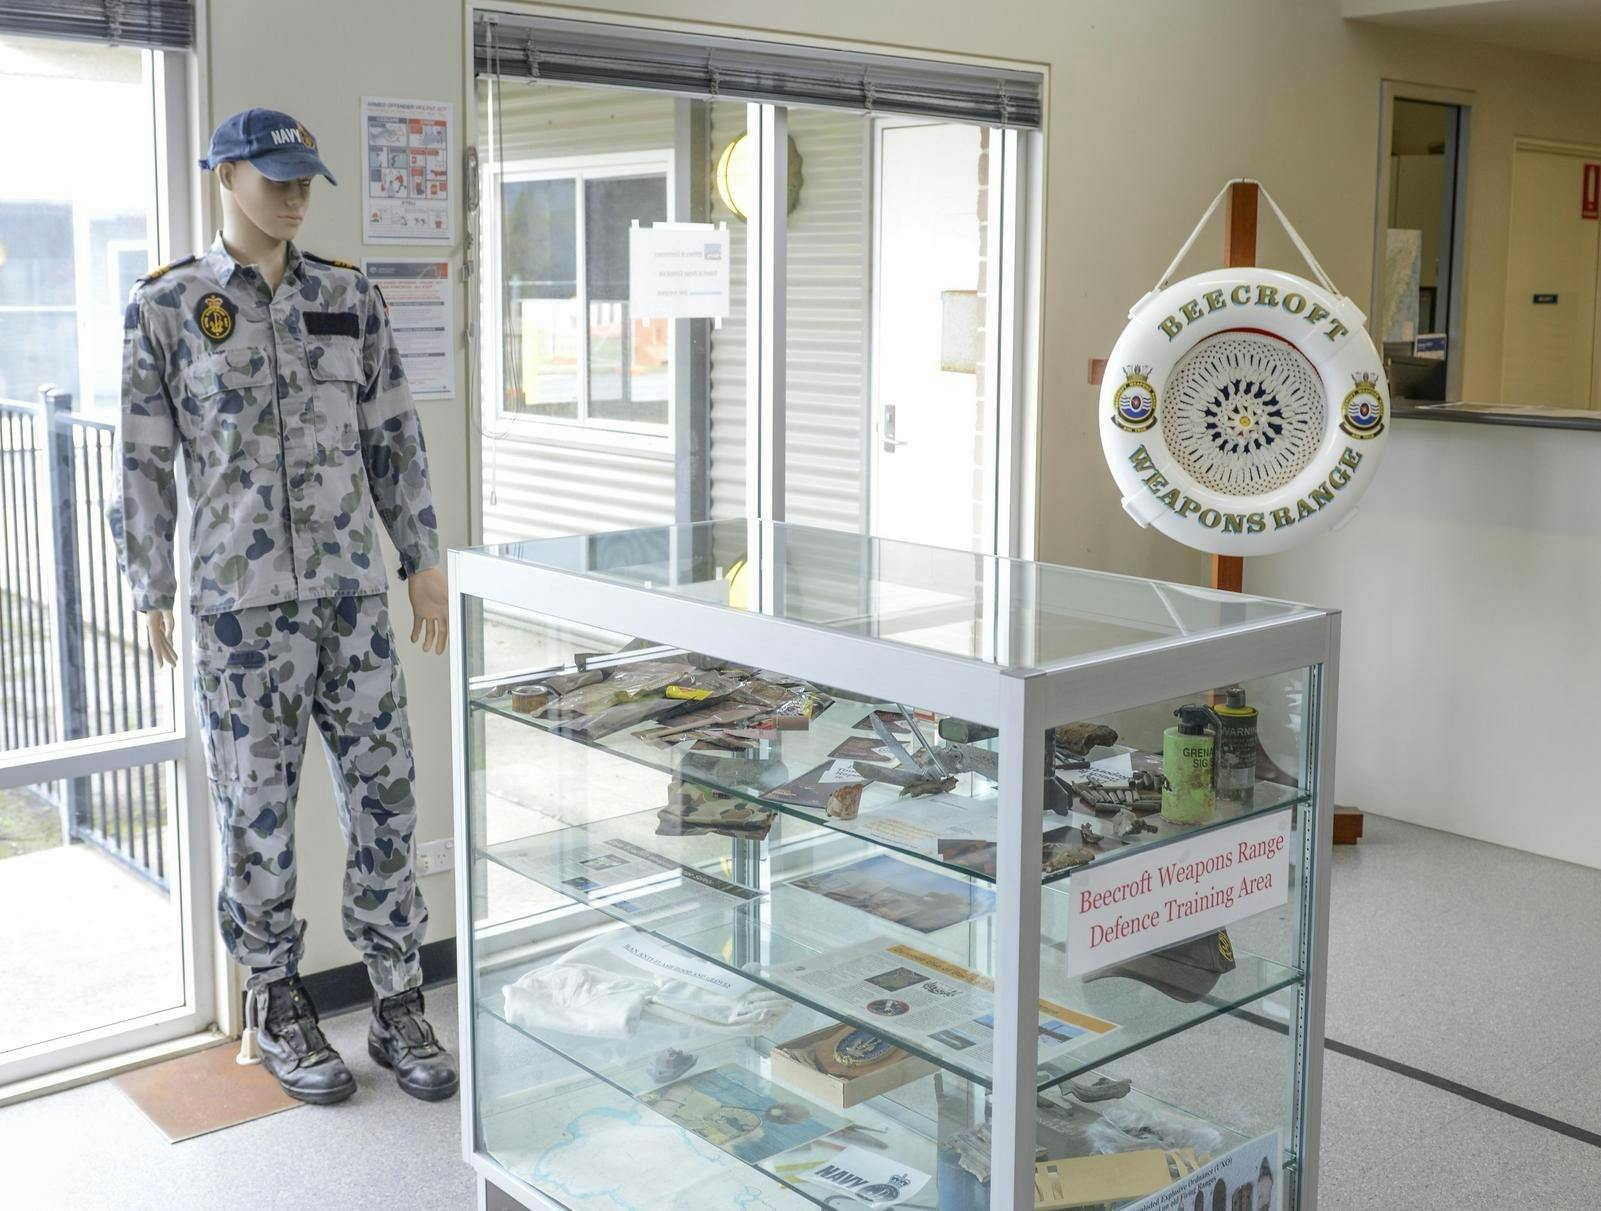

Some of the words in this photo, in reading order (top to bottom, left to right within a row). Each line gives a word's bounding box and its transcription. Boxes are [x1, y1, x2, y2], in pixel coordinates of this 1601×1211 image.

[271, 128, 302, 145] NAVY
[1157, 284, 1349, 342] BEECROFT
[1128, 444, 1267, 535] WEAPONS
[1269, 446, 1364, 532] RANGE
[1079, 869, 1153, 915] Beecroft
[1157, 850, 1233, 889] Weapons
[1237, 834, 1285, 864] Range
[1090, 914, 1160, 949] Defence
[1164, 885, 1235, 923] Training
[1236, 872, 1273, 899] Area
[814, 1164, 870, 1189] NAVY
[1187, 1167, 1214, 1188] Ordnance
